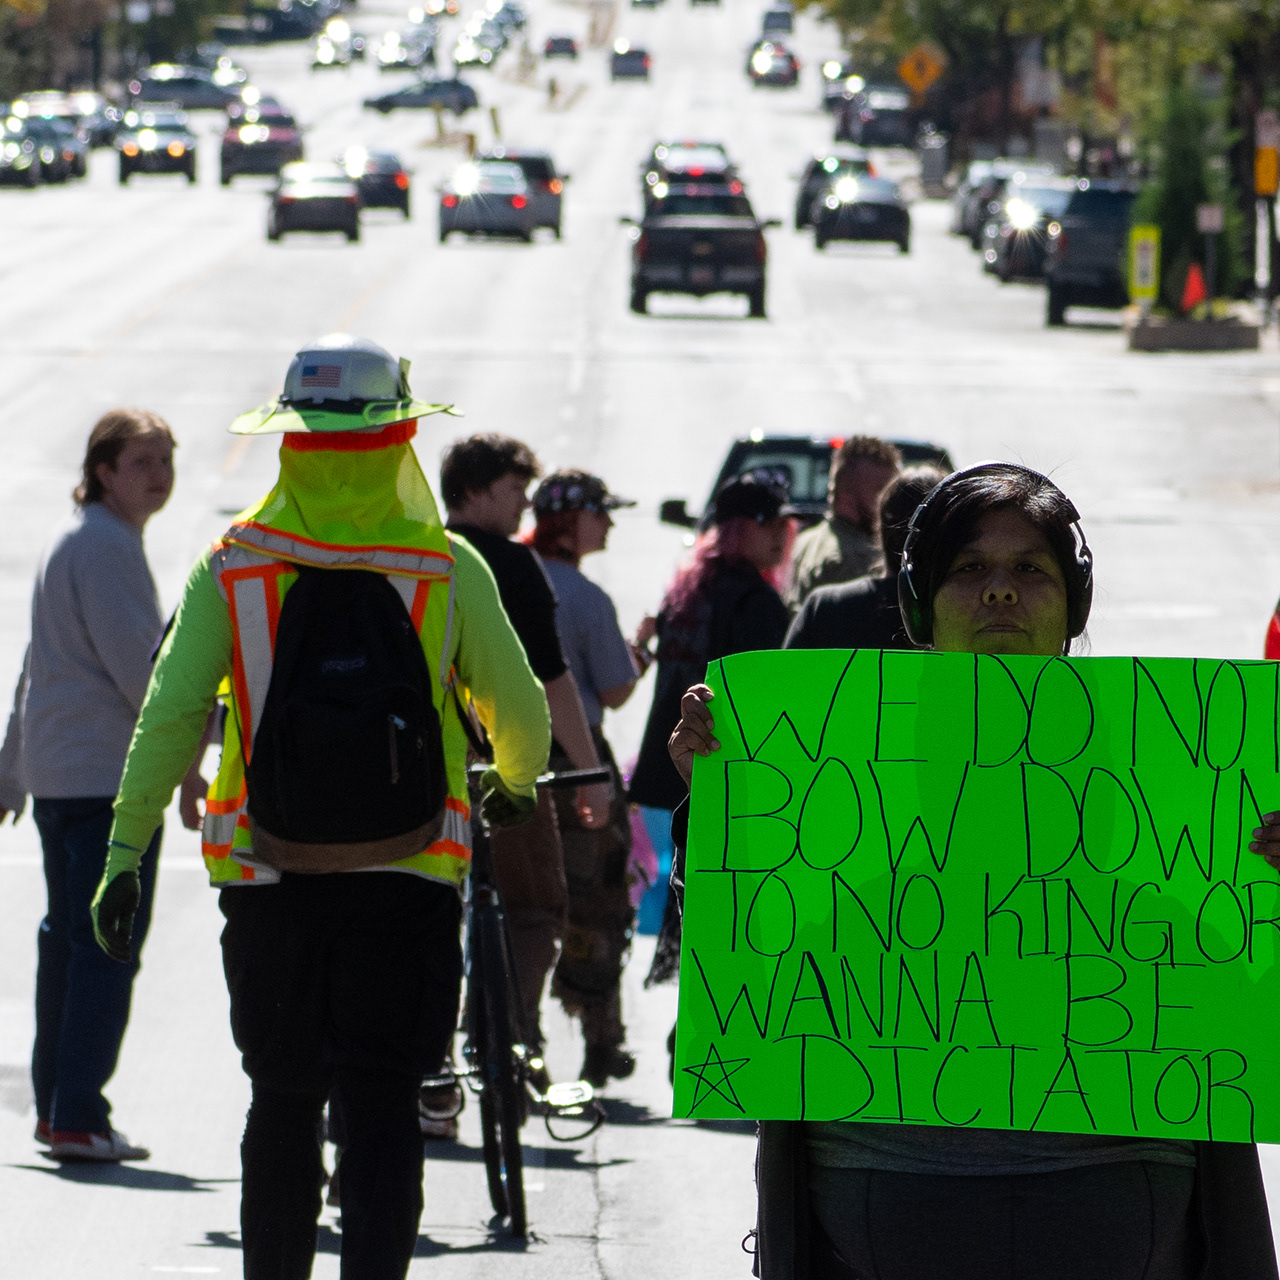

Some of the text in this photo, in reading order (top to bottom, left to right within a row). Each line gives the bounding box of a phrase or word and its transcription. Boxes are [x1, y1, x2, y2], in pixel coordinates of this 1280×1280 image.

[719, 648, 945, 763] WE
[973, 653, 1095, 768] DO
[722, 757, 970, 873] BOW
[695, 868, 797, 957] TO
[832, 870, 946, 954] NO
[985, 872, 1177, 968] KING
[691, 948, 1207, 1052] WANNA BE
[772, 1033, 1256, 1144] DICTATOR
